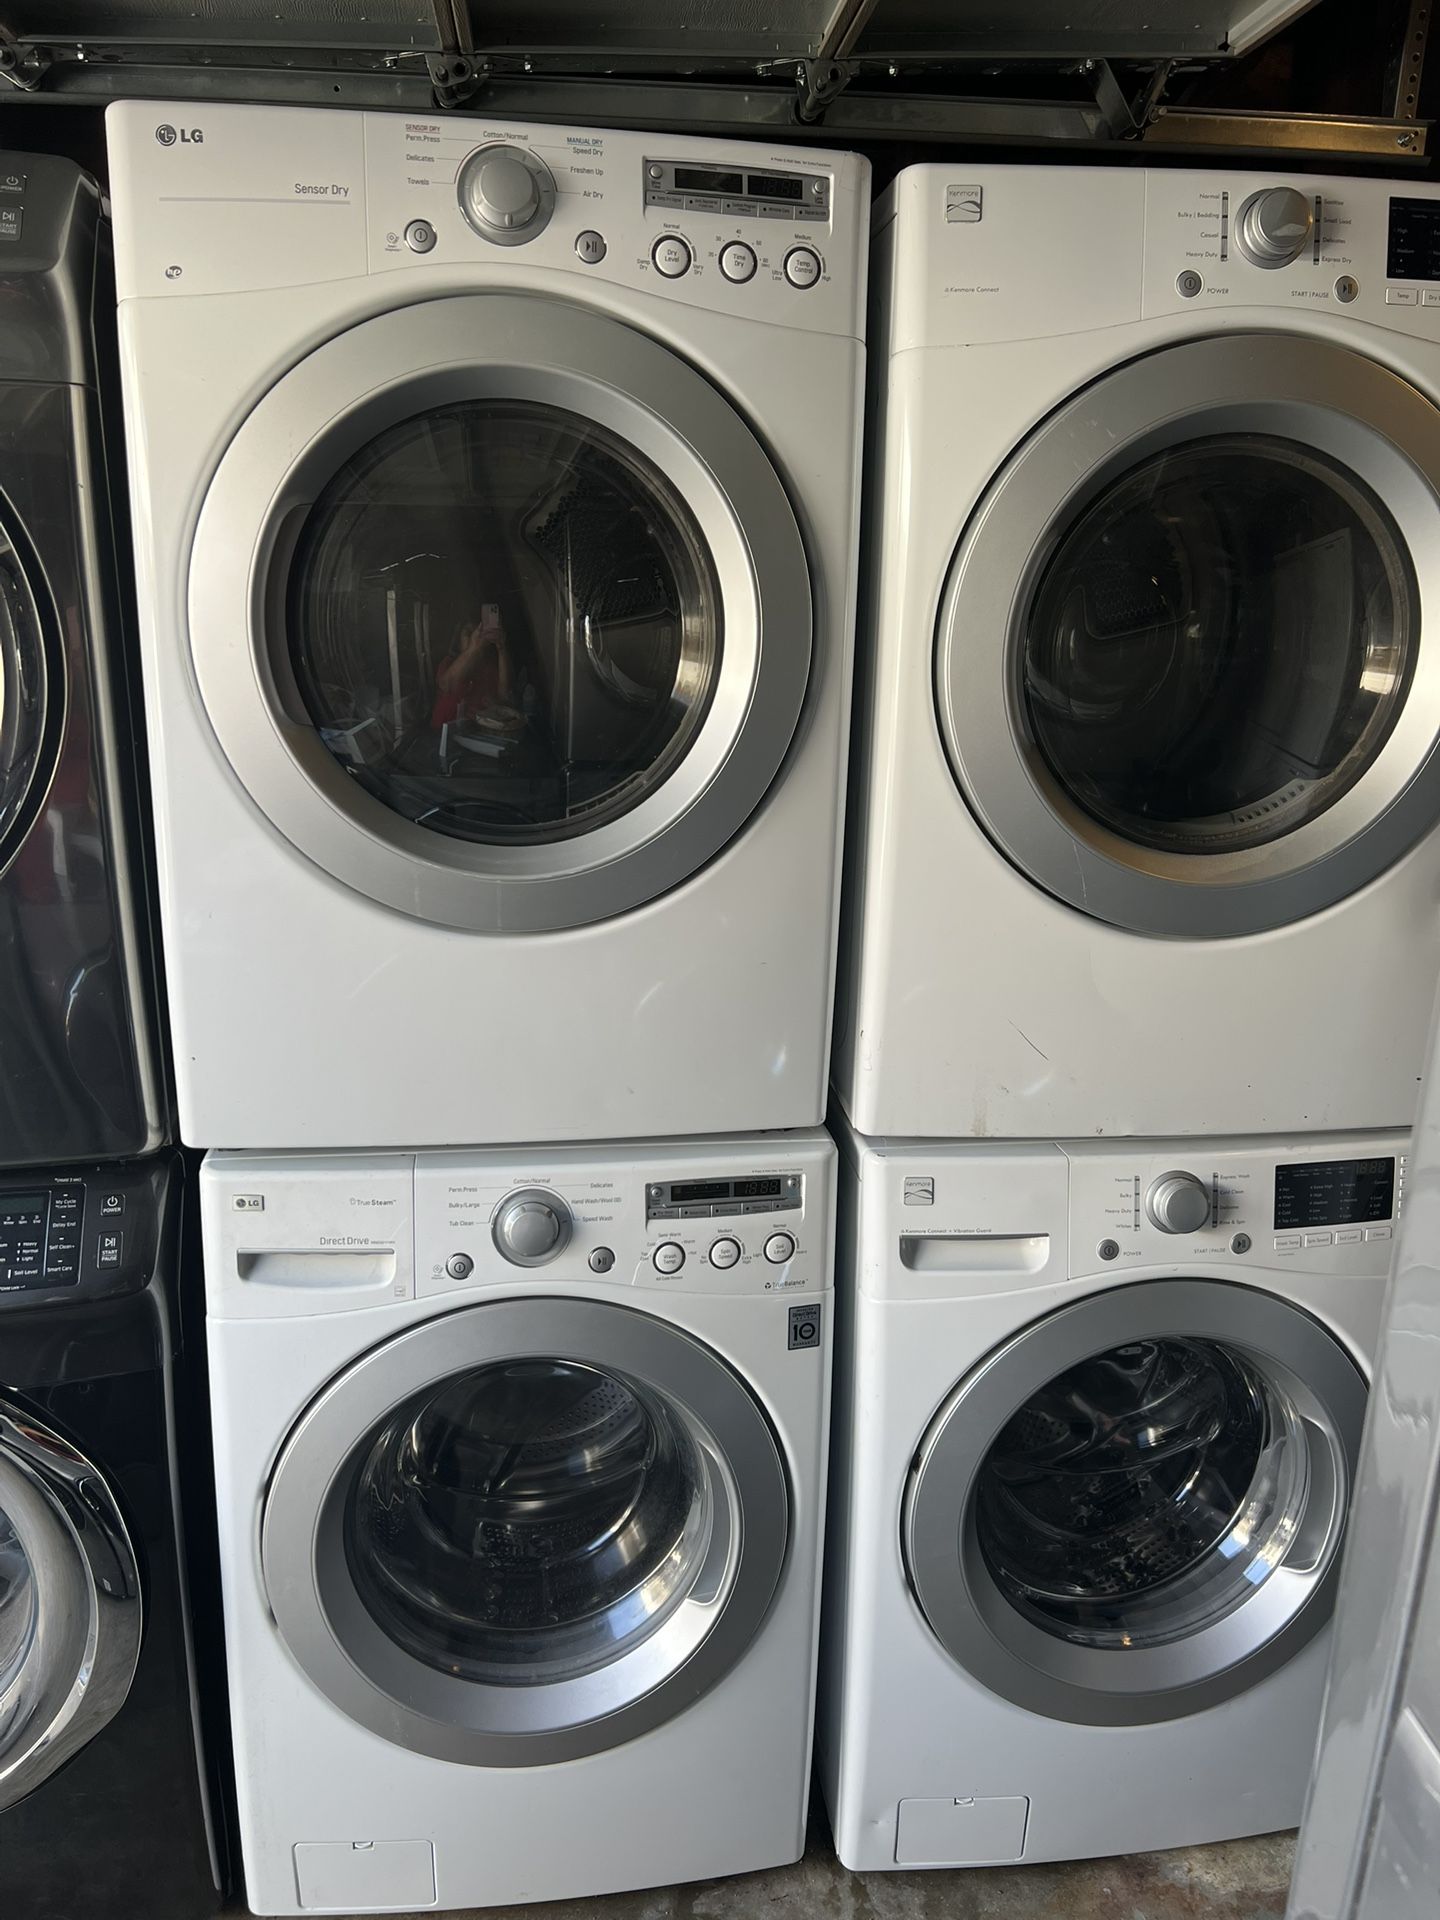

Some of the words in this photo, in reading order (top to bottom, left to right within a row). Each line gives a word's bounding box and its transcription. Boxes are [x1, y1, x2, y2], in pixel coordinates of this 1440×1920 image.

[405, 124, 427, 132] SENSOR
[180, 129, 204, 144] LG
[483, 130, 528, 141] Cotton/Normal
[566, 137, 591, 146] MANUAL
[592, 139, 603, 147] DRY
[573, 147, 591, 156] Speed
[592, 148, 604, 157] Dry
[406, 154, 434, 163] Delicates
[570, 166, 594, 175] Freshen
[595, 168, 604, 176] Up
[407, 178, 430, 186] Towels
[294, 183, 329, 195] Sensor
[332, 184, 350, 197] Dry
[582, 190, 592, 198] Air
[592, 191, 604, 200] Dry
[663, 222, 680, 230] Normal
[794, 233, 812, 241] Medium
[667, 249, 678, 257] Dry
[734, 260, 744, 268] Dry
[1322, 256, 1341, 264] Express
[794, 266, 814, 274] Control
[793, 1322, 816, 1342] 10
